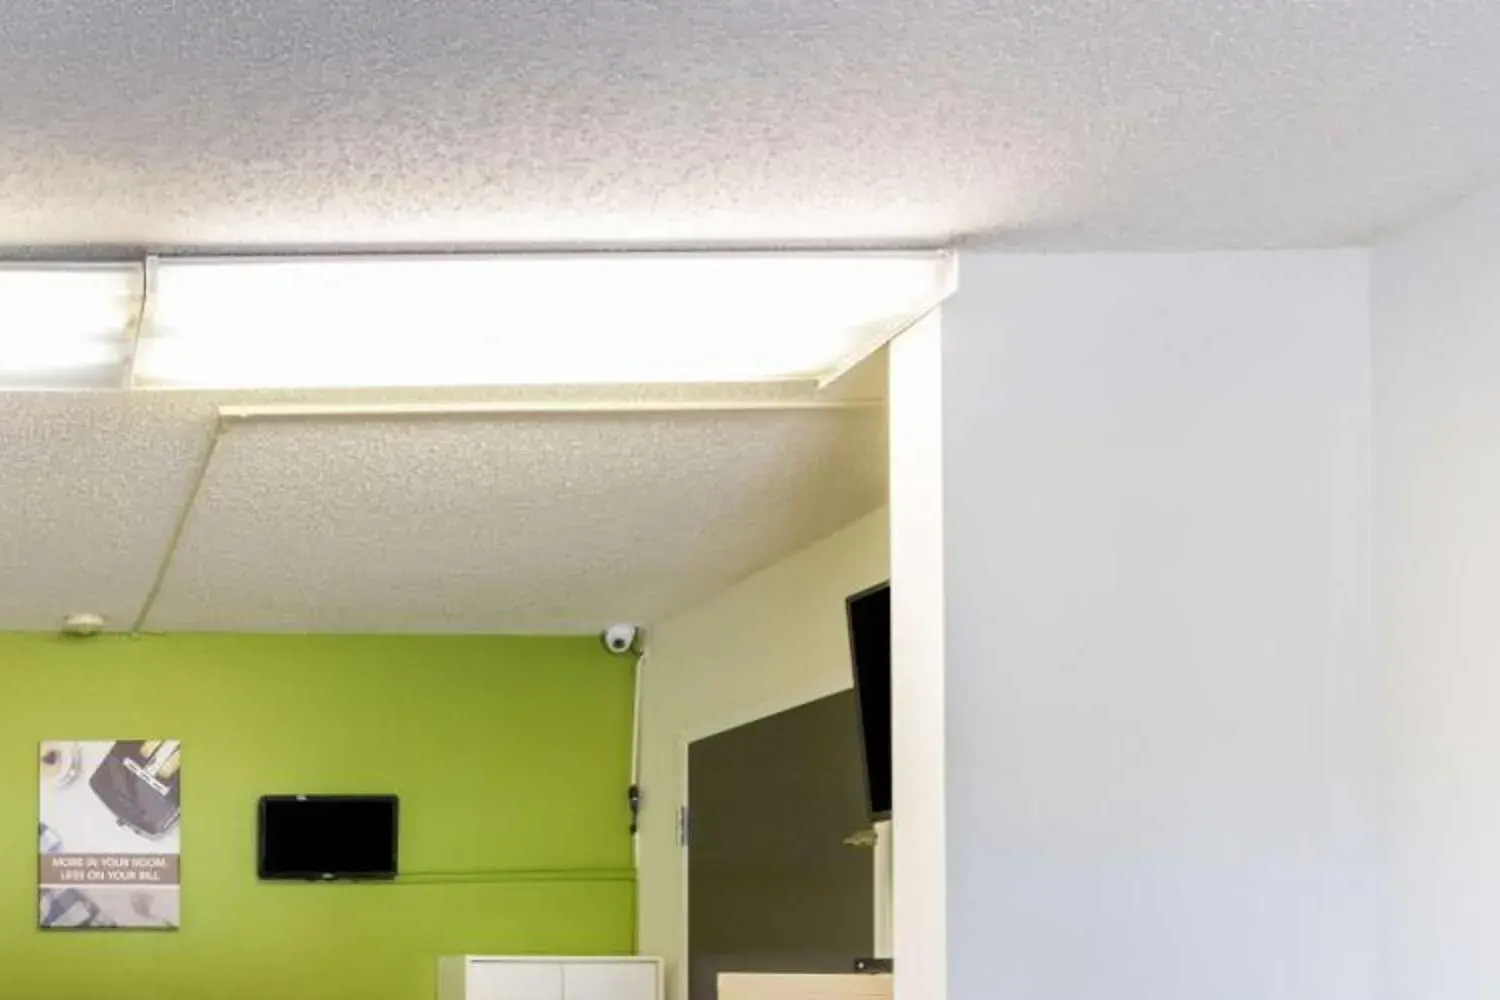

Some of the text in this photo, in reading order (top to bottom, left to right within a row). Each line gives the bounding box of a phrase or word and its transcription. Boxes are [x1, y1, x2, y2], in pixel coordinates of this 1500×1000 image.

[51, 857, 84, 867] MORE
[87, 857, 99, 868] IN
[101, 857, 129, 867] YOUR
[60, 869, 84, 880] LESS
[87, 869, 105, 880] ON
[108, 869, 136, 880] YOUR
